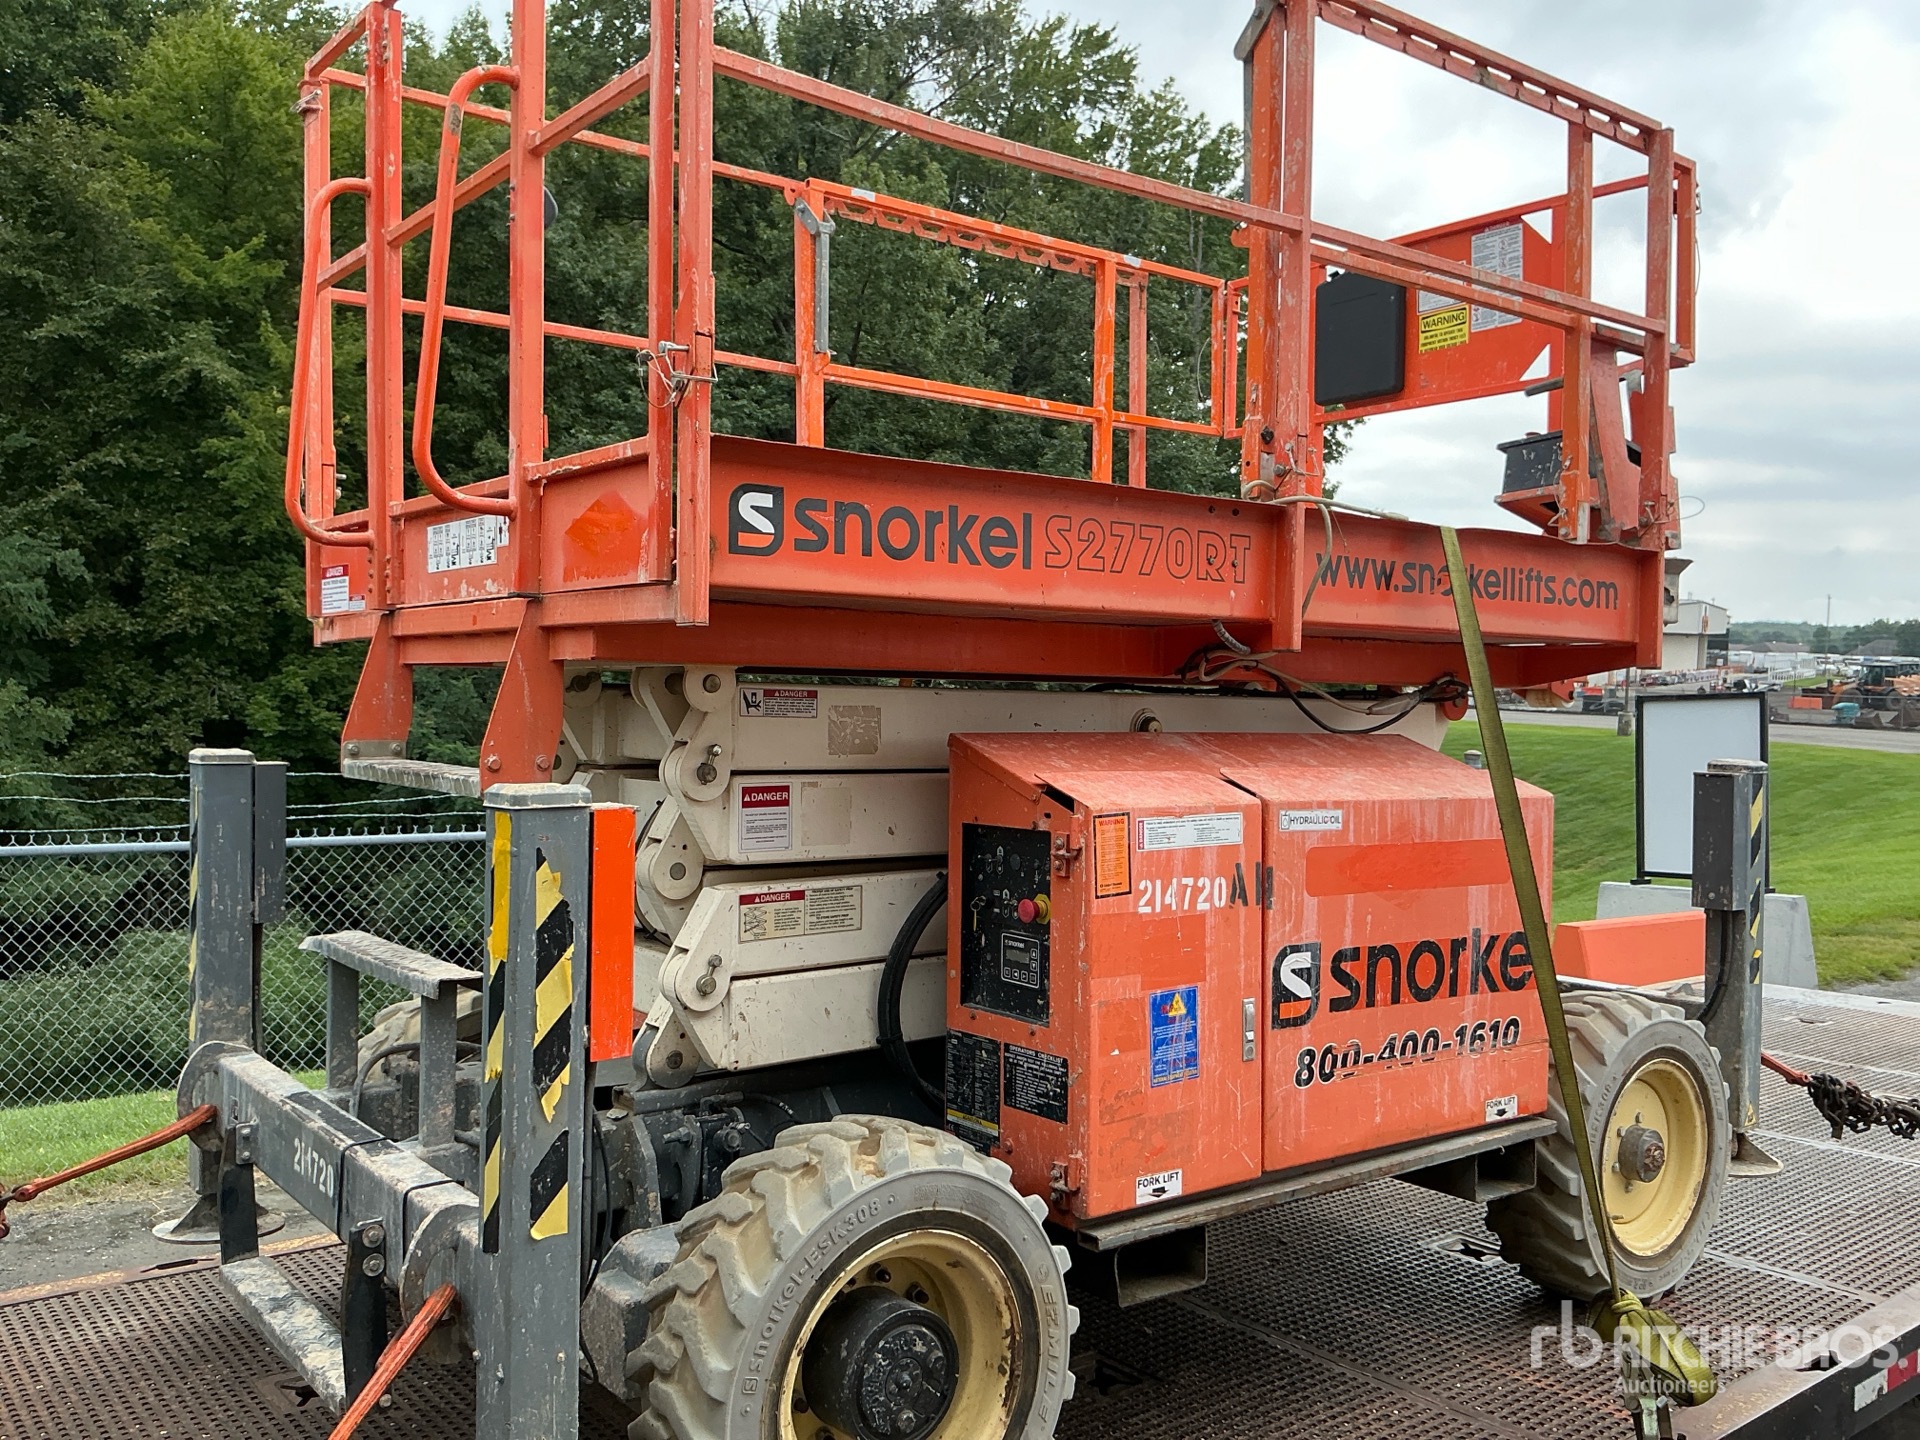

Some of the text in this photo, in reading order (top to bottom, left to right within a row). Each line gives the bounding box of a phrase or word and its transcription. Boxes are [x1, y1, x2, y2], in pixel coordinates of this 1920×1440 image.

[1422, 312, 1465, 329] WARNING
[794, 497, 1032, 570] snorkel
[1045, 514, 1251, 584] S2770RT
[1316, 552, 1618, 610] www.snokellifts.com
[780, 690, 808, 698] DANGER
[751, 792, 788, 801] DANGER
[1290, 814, 1341, 825] HYDRAULIC OIL
[761, 893, 790, 902] DANGER
[1138, 876, 1227, 914] 214720
[1329, 927, 1534, 1013] snorke
[1294, 1016, 1520, 1088] 800-400-1610
[1487, 1097, 1515, 1109] FORK LIFT
[1137, 1171, 1180, 1189] FORK LIFT
